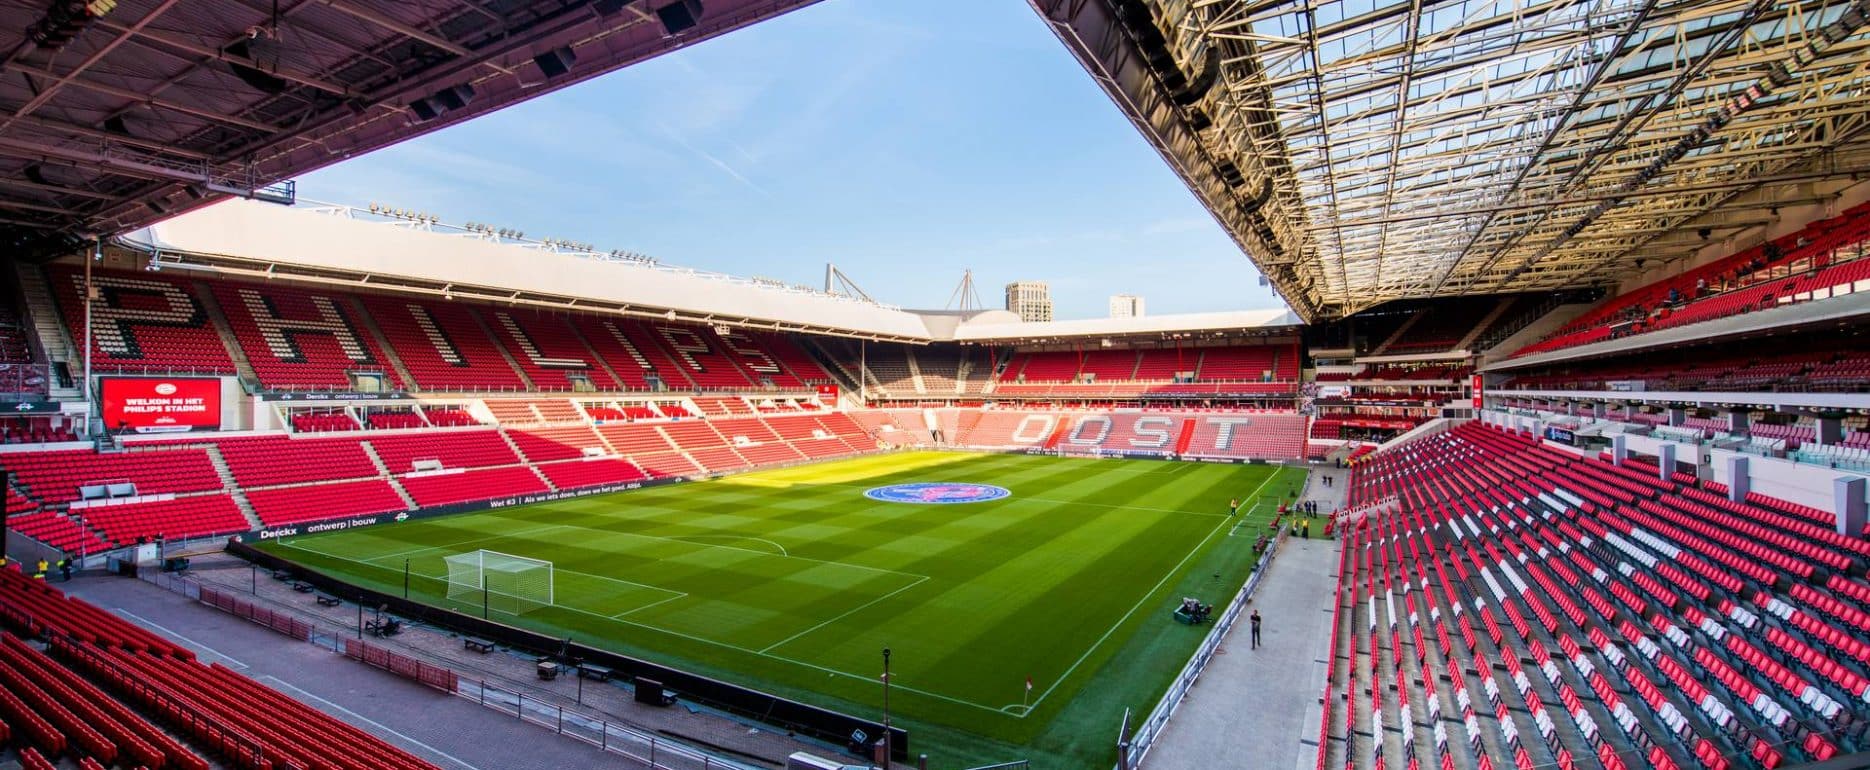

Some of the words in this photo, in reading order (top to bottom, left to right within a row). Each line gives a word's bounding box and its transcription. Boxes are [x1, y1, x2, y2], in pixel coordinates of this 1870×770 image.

[71, 274, 783, 373] PHILIPS
[123, 405, 163, 413] PHILIPS
[1012, 415, 1249, 450] OOST
[490, 499, 505, 508] Wet
[524, 495, 535, 503] Als
[260, 527, 297, 539] Derckx
[307, 521, 346, 533] ontwerp
[352, 517, 376, 527] bouw
